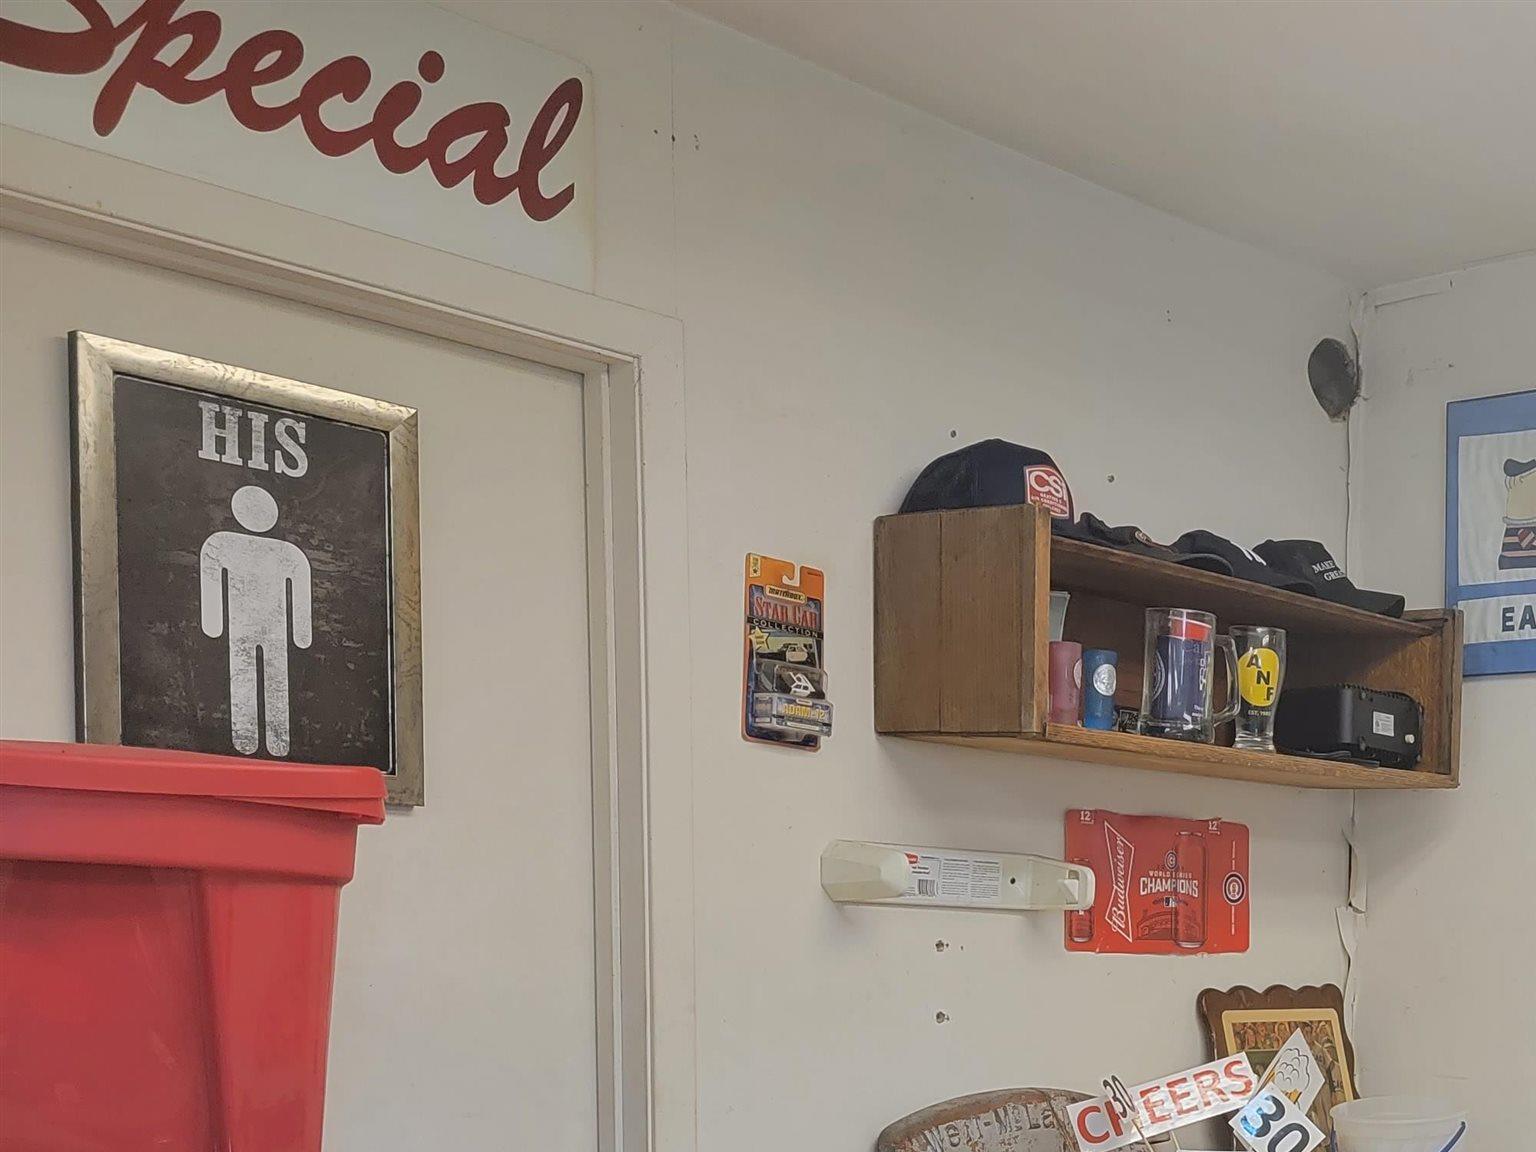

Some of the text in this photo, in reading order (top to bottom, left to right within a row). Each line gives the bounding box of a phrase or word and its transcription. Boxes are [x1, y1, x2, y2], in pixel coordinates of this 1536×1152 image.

[198, 401, 308, 479] HIS
[752, 617, 819, 638] COLLECTION
[1080, 810, 1091, 821] 12
[1111, 834, 1127, 932] Budweiser
[1140, 877, 1198, 897] CHAMPIONS
